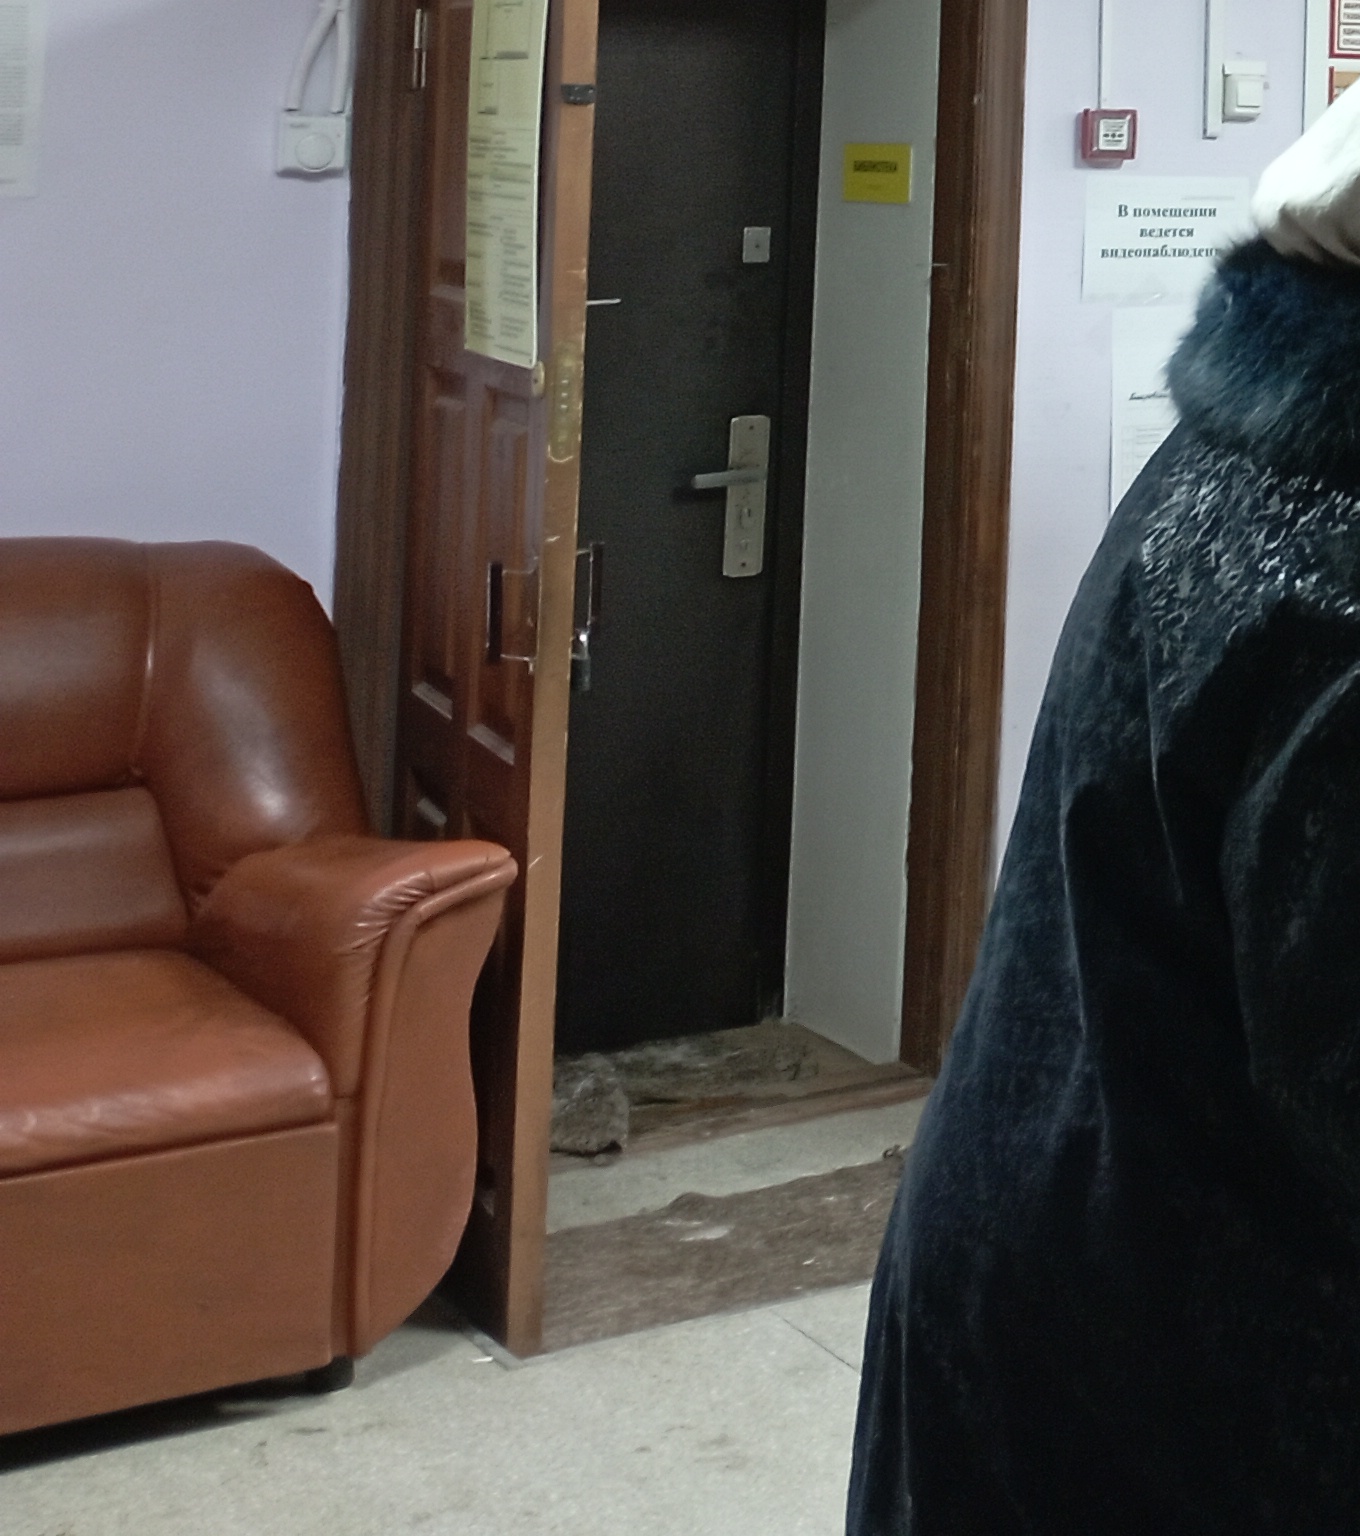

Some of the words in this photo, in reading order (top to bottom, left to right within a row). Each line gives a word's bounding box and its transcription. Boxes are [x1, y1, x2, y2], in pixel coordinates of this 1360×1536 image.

[1117, 203, 1129, 218] В
[1132, 206, 1217, 219] помещении
[1139, 227, 1195, 239] ведется
